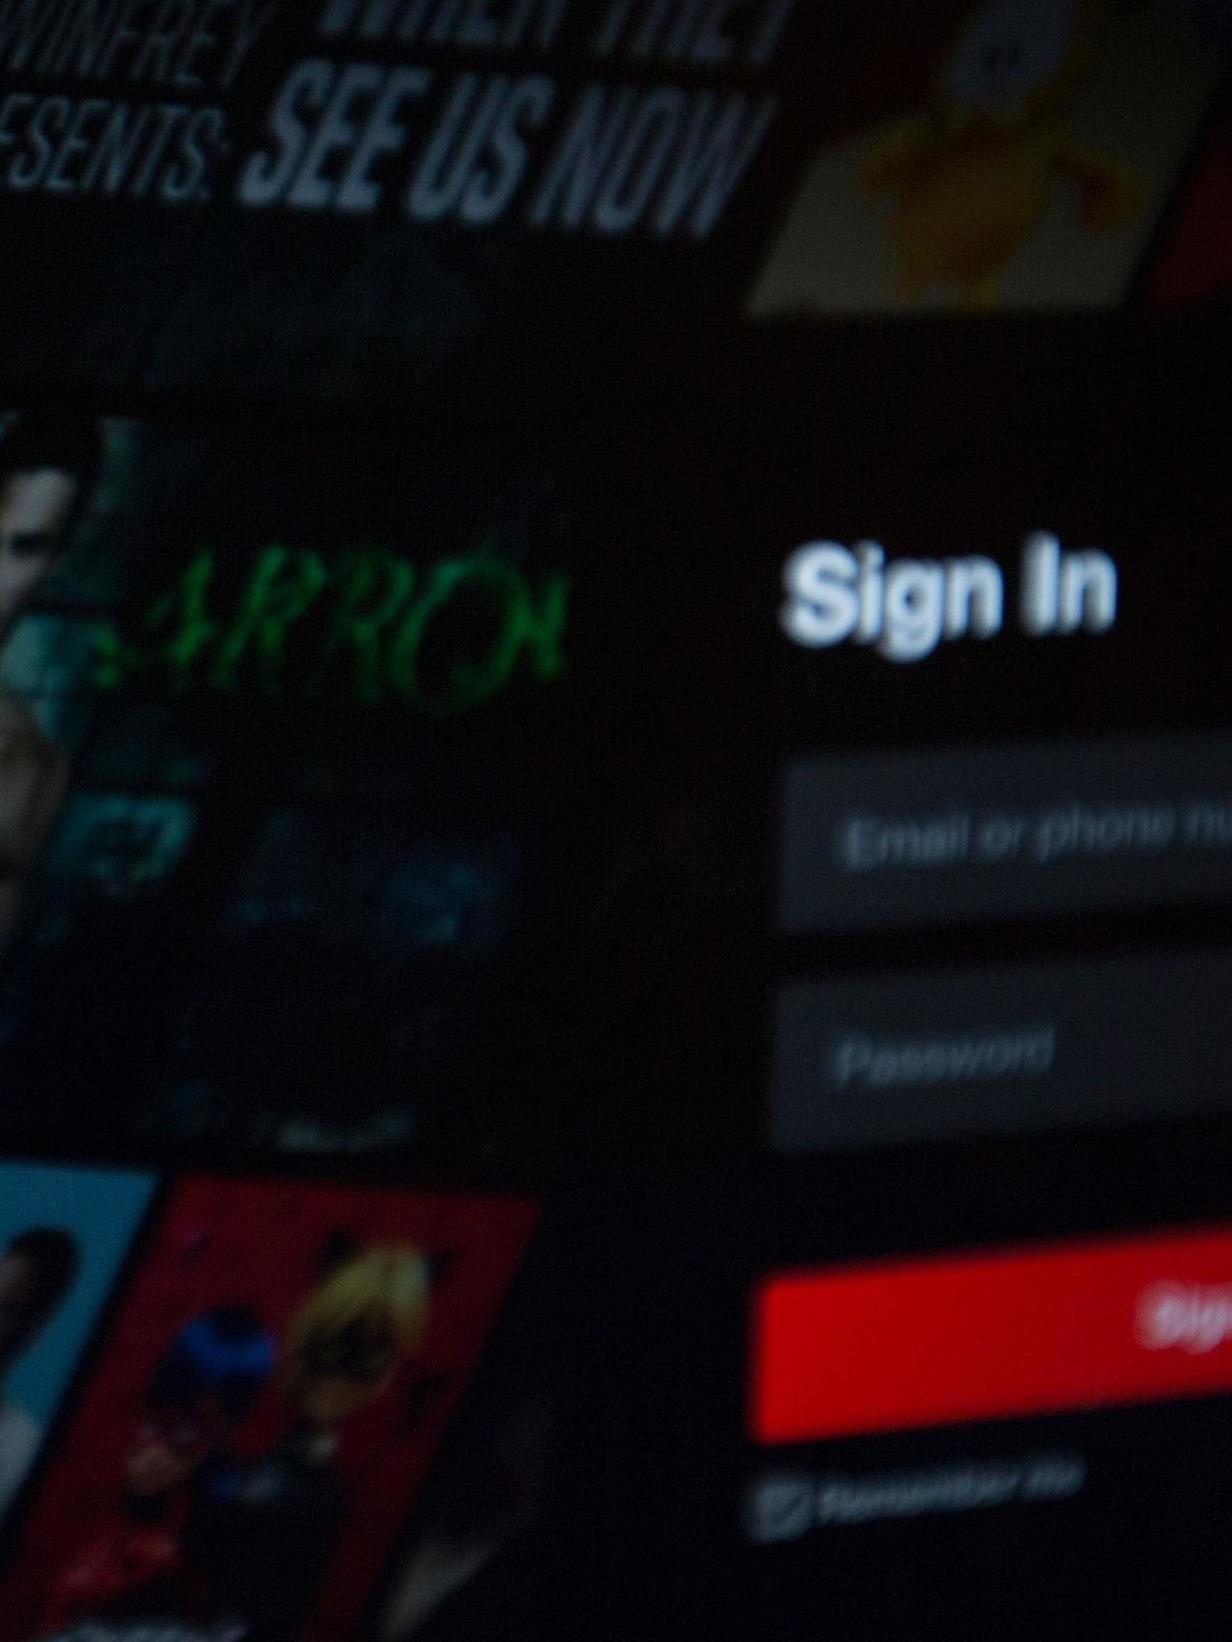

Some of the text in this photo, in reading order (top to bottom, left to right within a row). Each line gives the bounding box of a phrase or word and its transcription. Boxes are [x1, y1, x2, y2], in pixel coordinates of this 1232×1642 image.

[240, 55, 778, 240] SEE US NOW
[780, 528, 1118, 664] Sign In
[840, 808, 971, 870] Email
[976, 812, 1028, 865] or
[1036, 797, 1176, 864] phone
[830, 1021, 1058, 1090] Password
